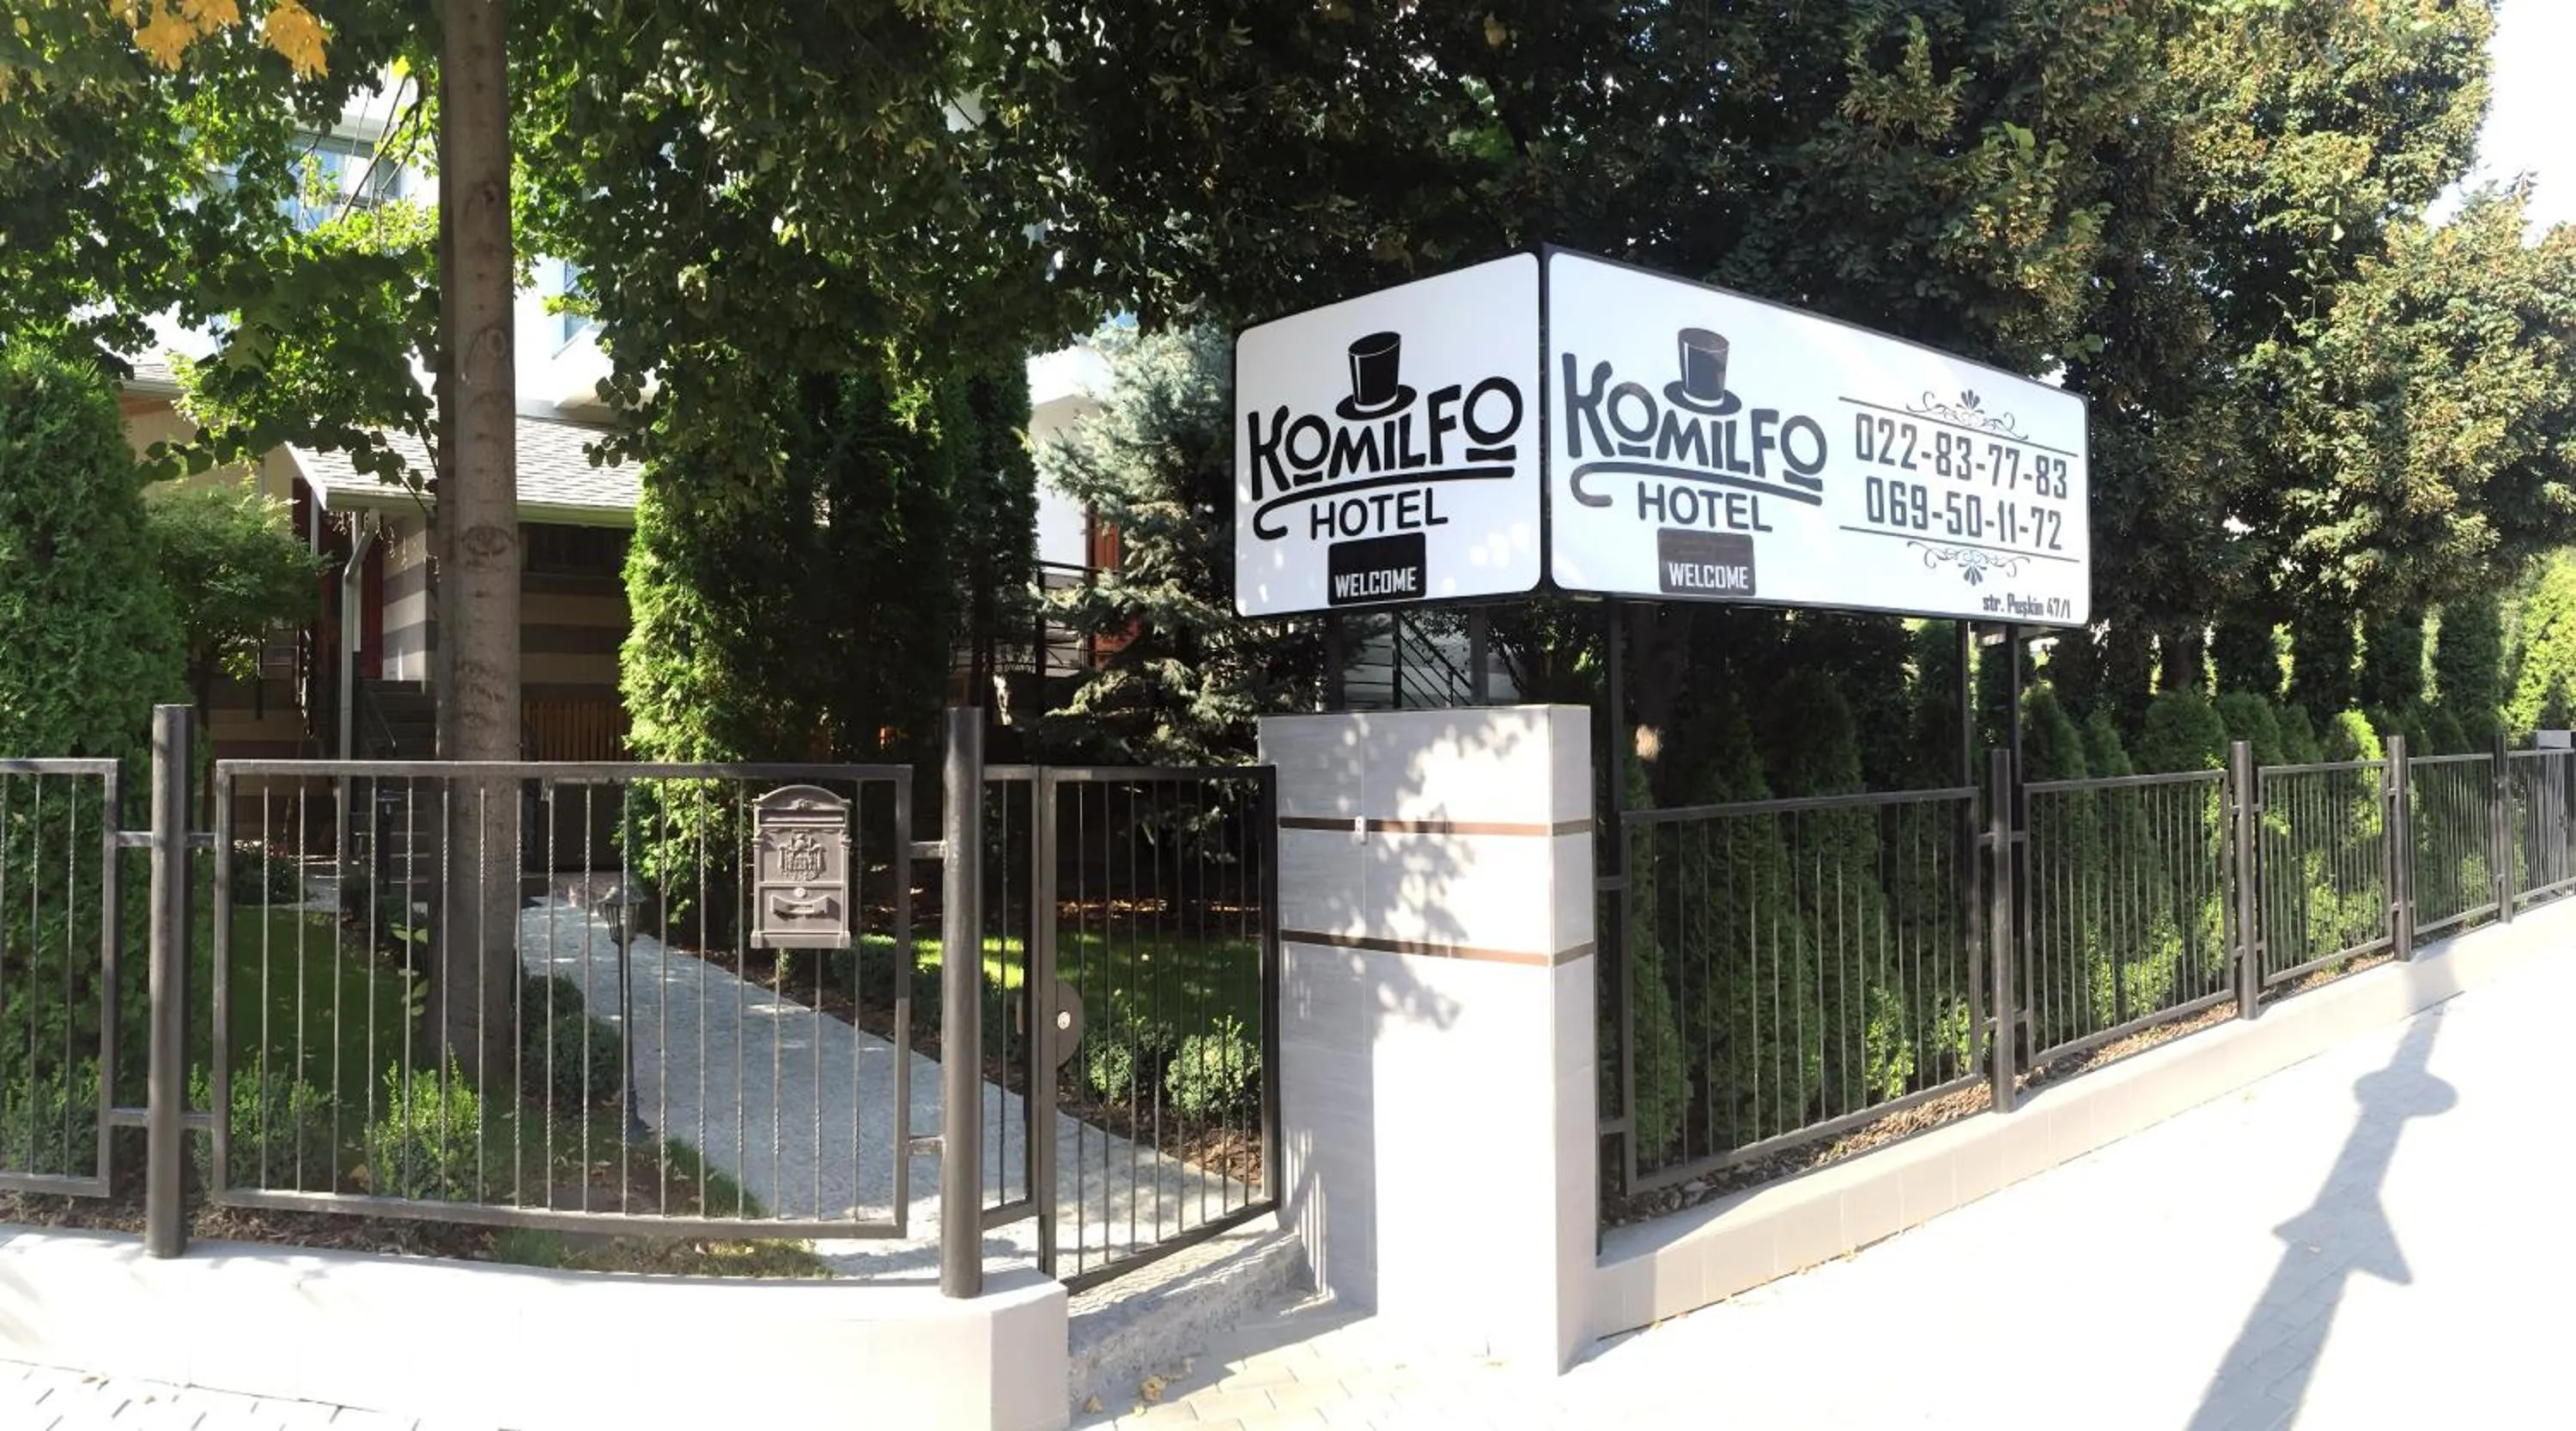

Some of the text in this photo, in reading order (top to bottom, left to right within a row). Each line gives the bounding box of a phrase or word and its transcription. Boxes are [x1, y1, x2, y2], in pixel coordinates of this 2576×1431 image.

[1248, 376, 1523, 501] KOMILFO
[1562, 352, 1827, 491] KOMILFO
[1856, 412, 2067, 499] 022-83-77-83
[1310, 487, 1449, 540] HOTEL
[1638, 481, 1773, 533] HOTEL
[1866, 476, 2062, 551] 069-50-11-72
[1335, 566, 1418, 599] WELCOME
[1668, 563, 1749, 589] WELCOME
[1983, 594, 2005, 612] str.
[2046, 599, 2071, 618] 47/1
